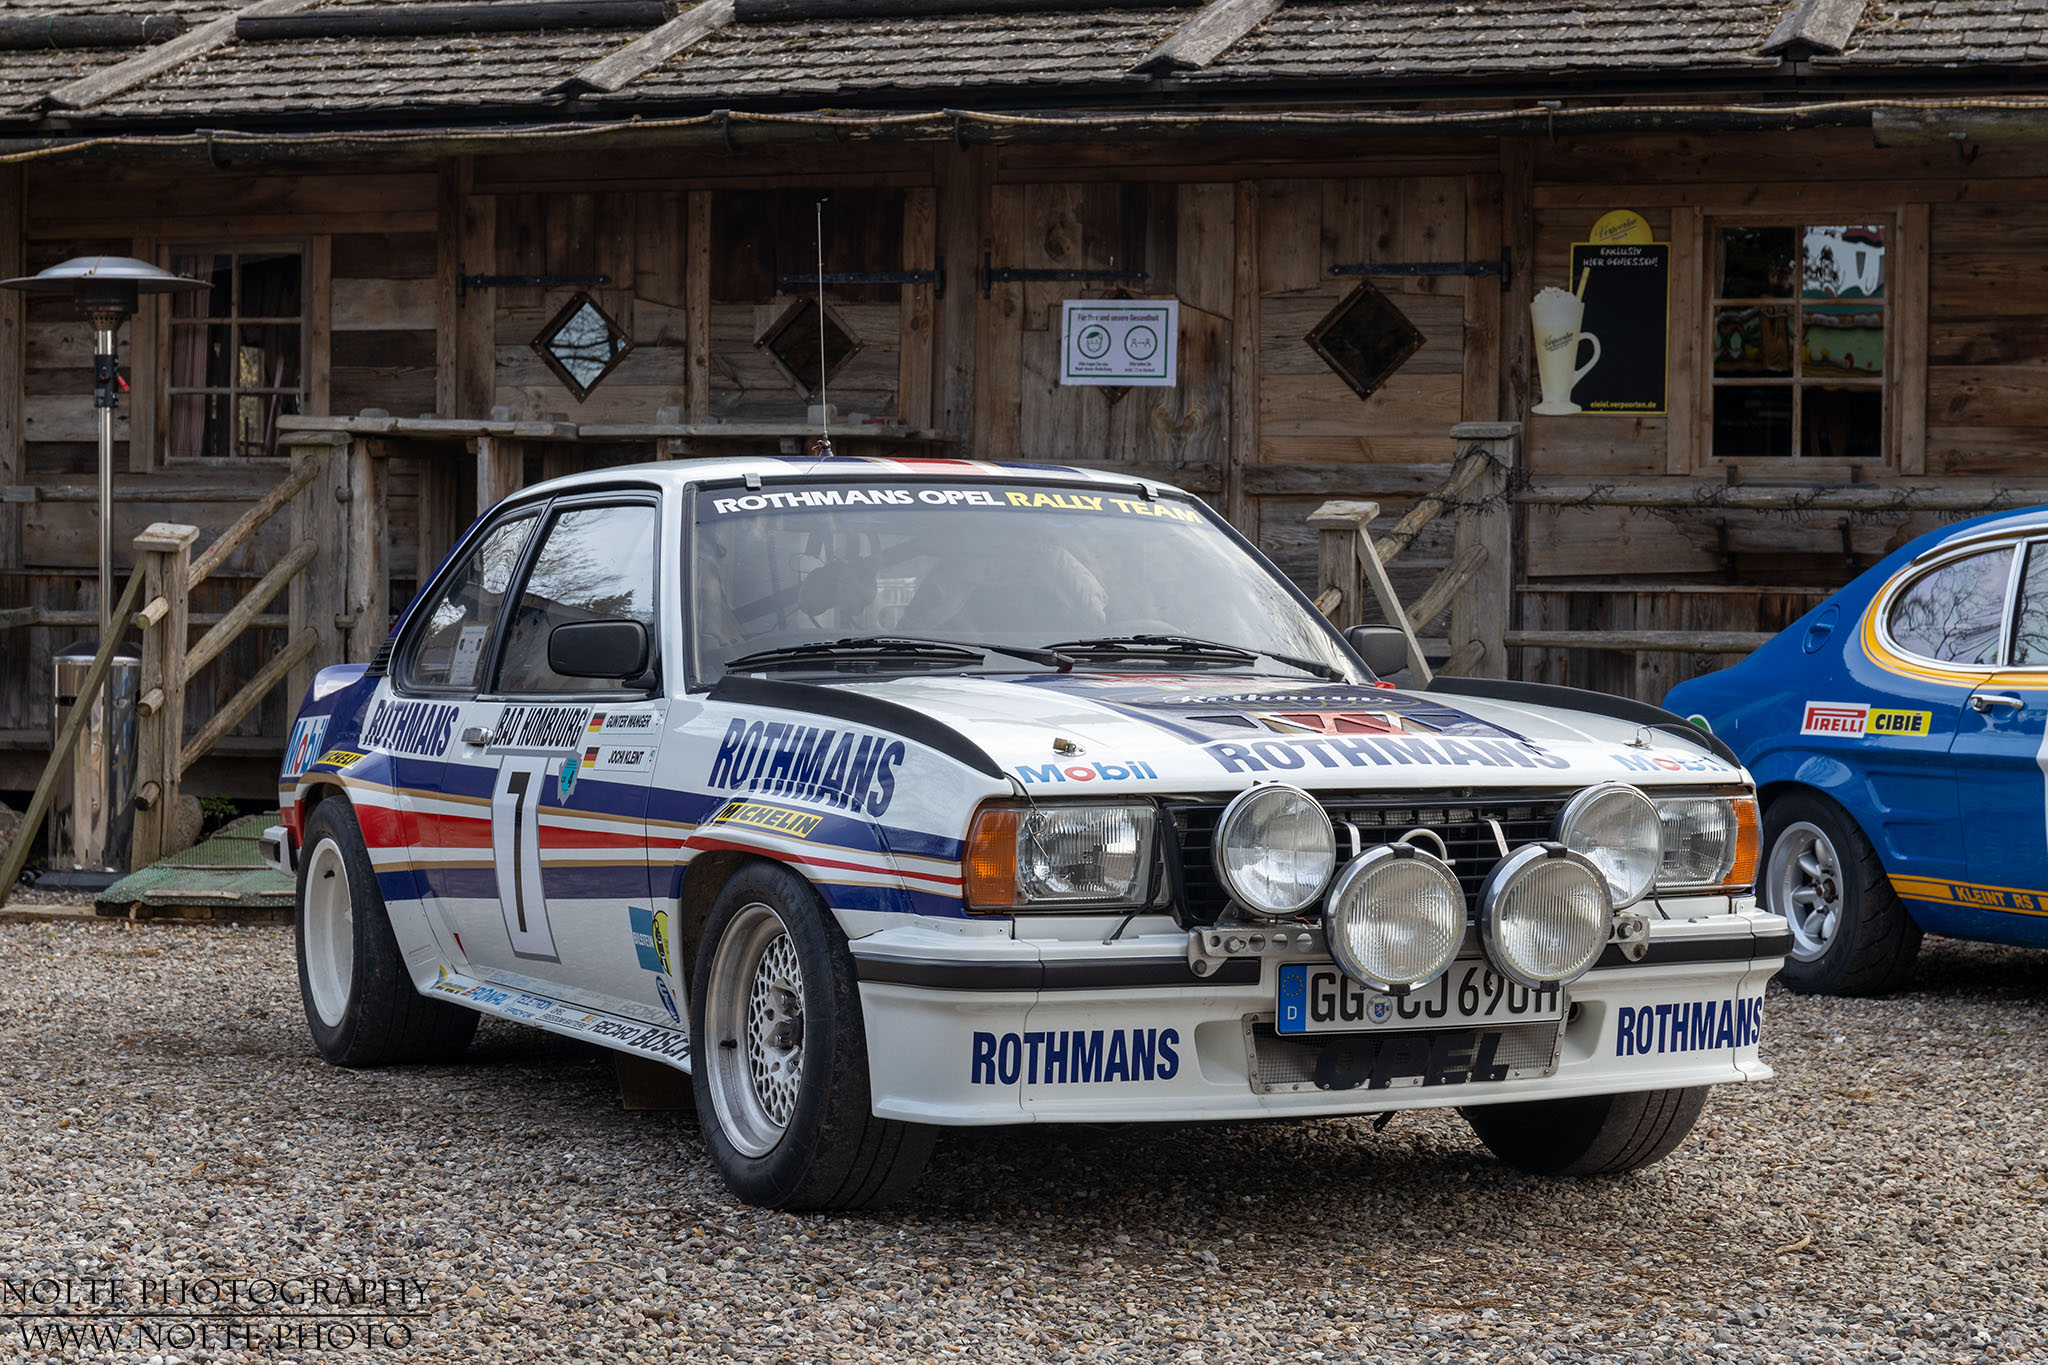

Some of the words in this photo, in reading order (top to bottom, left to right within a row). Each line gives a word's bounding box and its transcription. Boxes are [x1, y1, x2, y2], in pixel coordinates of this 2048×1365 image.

[1583, 257, 1605, 267] HIER
[1607, 257, 1658, 267] GENIESSEN!
[1600, 247, 1642, 256] EXKLUSIV
[712, 489, 914, 514] ROTHMANS
[918, 490, 1006, 506] OPEL
[1005, 491, 1104, 511] RALLY
[1108, 498, 1203, 524] TEAM
[363, 699, 460, 757] ROTHMANS
[492, 707, 526, 746] BAD
[516, 707, 589, 747] HOMBOURG
[1805, 707, 1867, 734] PIRELLI
[282, 718, 330, 775] Mobil
[1202, 737, 1571, 774] ROTHMANS
[707, 717, 906, 818] ROTHMANS
[1014, 760, 1158, 784] Mobil
[720, 802, 818, 835] MICHELIN
[507, 771, 532, 933] 7
[1956, 886, 2006, 907] KLEINT
[2015, 894, 2035, 909] RS
[466, 985, 511, 1006] RONAL
[1287, 1005, 1298, 1021] D
[1311, 971, 1364, 1023] GG
[588, 1020, 641, 1041] RECARO
[1616, 996, 1763, 1057] ROTHMANS
[627, 1028, 691, 1062] BOSCH
[971, 1027, 1180, 1085] ROTHMANS
[1313, 1032, 1510, 1091] OPEL
